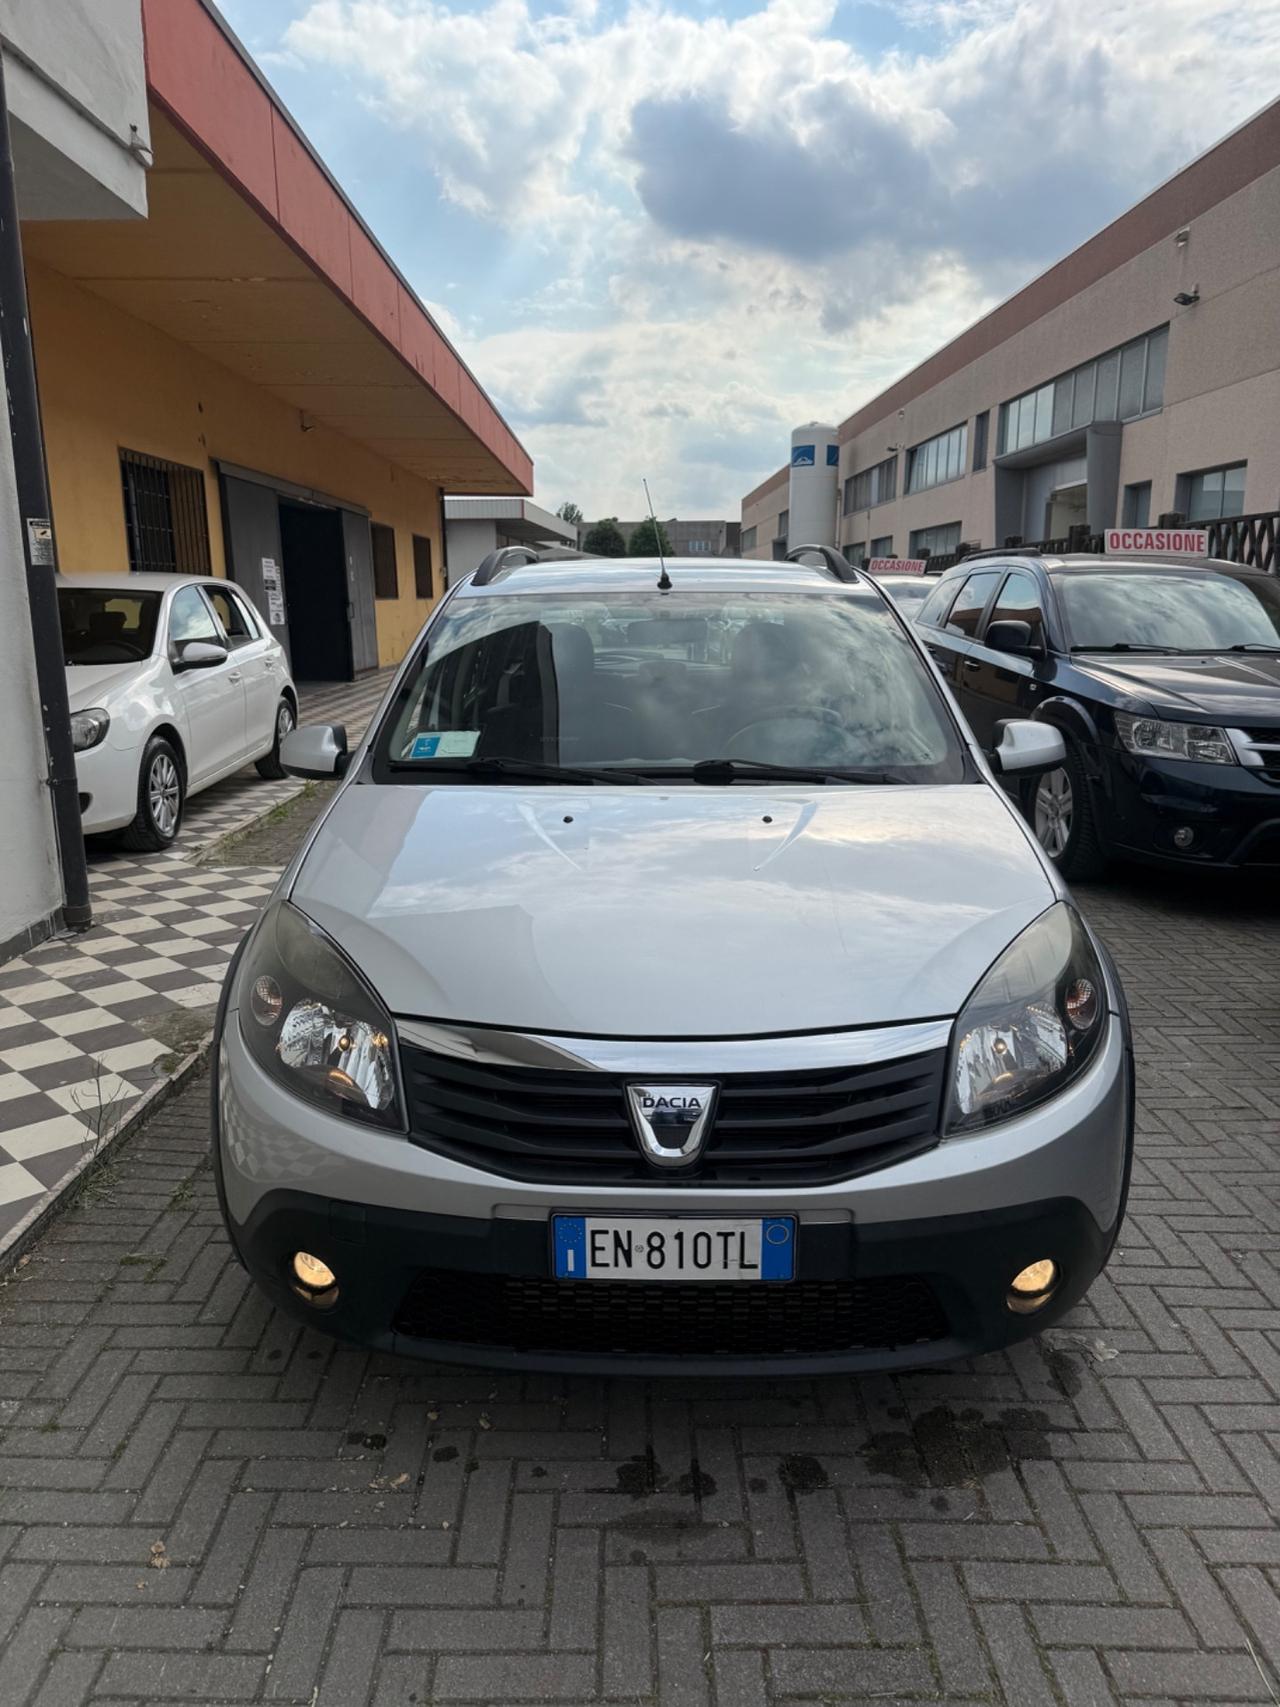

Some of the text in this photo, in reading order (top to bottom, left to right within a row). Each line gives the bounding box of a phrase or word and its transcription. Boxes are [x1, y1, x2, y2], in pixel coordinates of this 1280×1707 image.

[1109, 532, 1205, 552] OCCASIONE
[870, 559, 924, 573] OCCASIONE
[642, 1097, 702, 1109] DACIA
